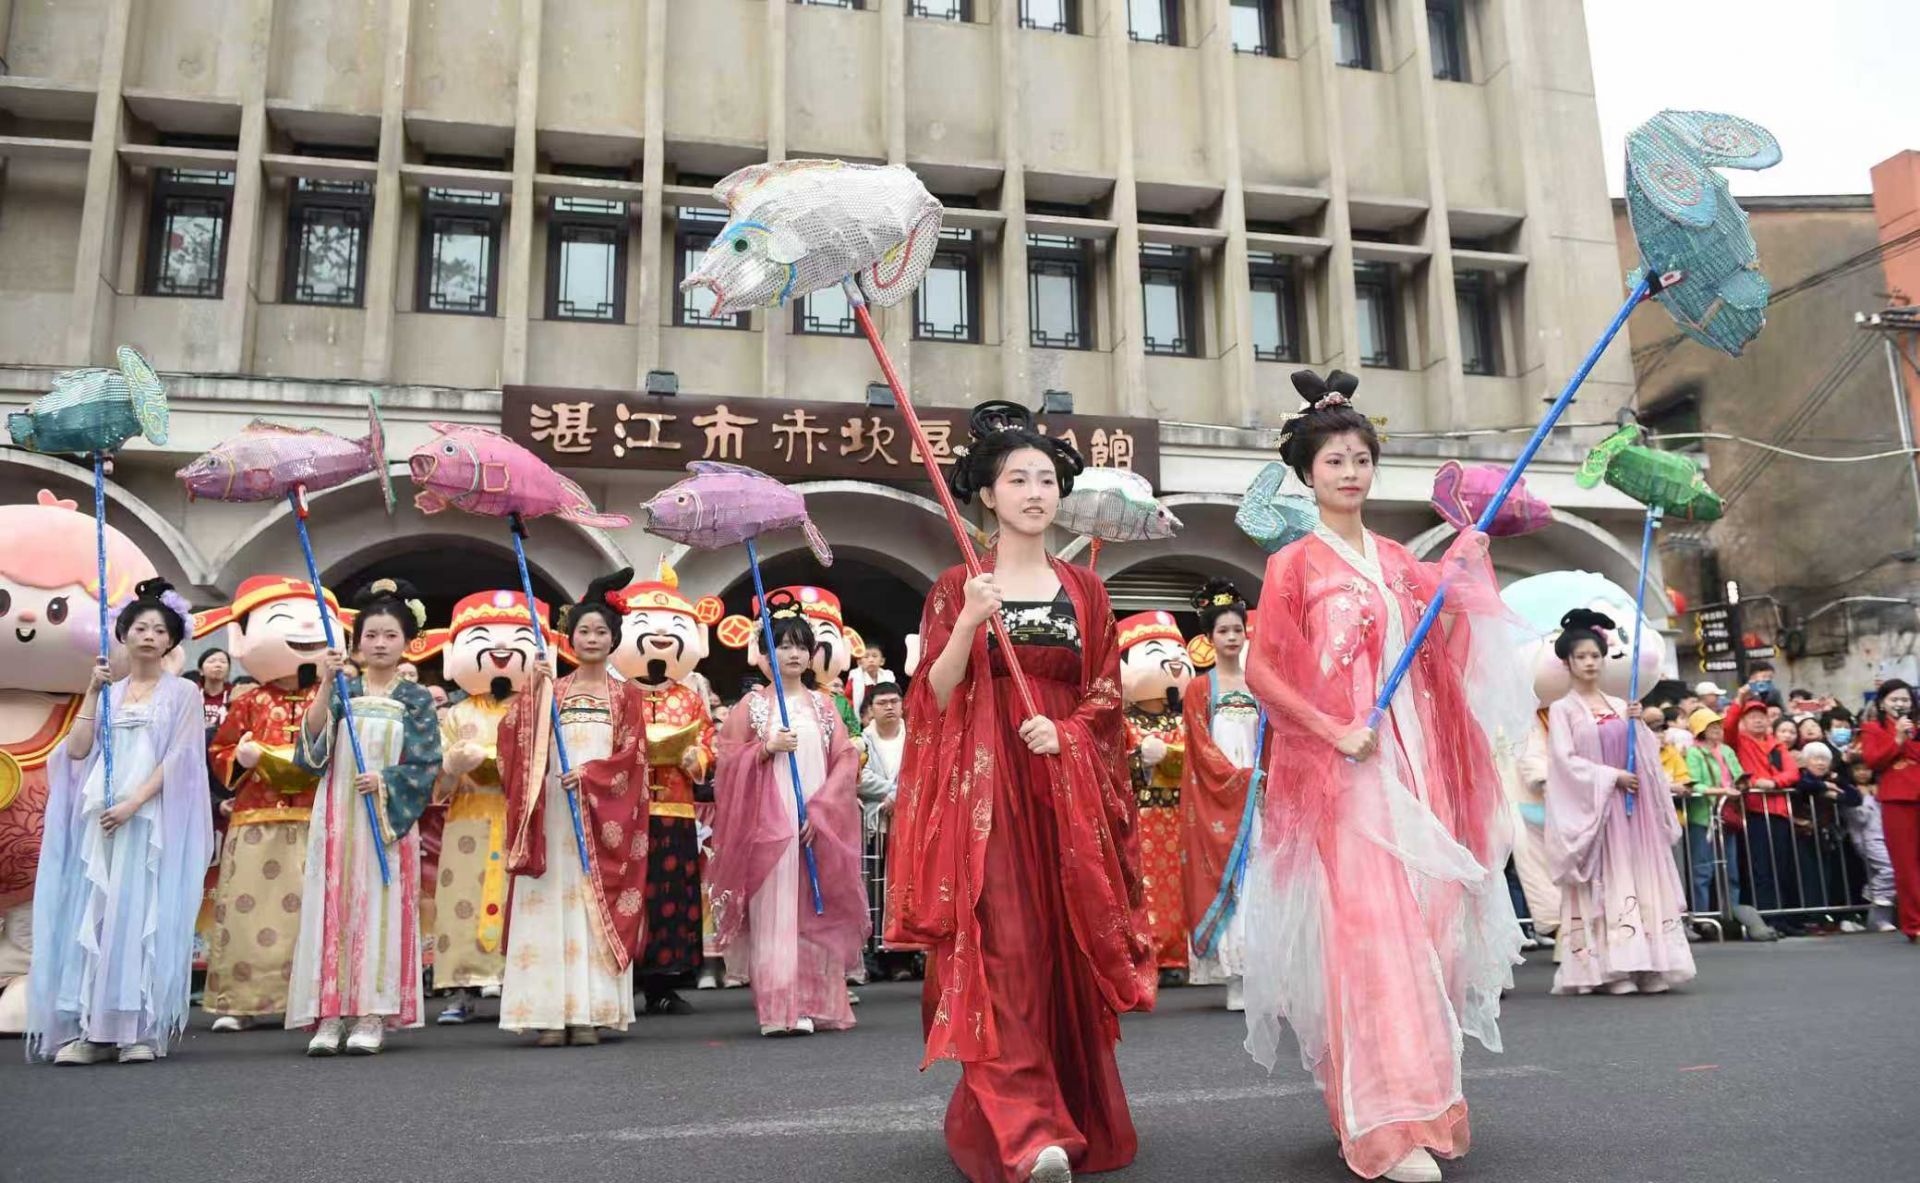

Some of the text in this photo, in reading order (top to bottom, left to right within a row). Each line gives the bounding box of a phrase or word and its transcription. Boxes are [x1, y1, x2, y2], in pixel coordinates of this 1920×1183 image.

[530, 401, 1134, 469] 湛江市赤坎區館
